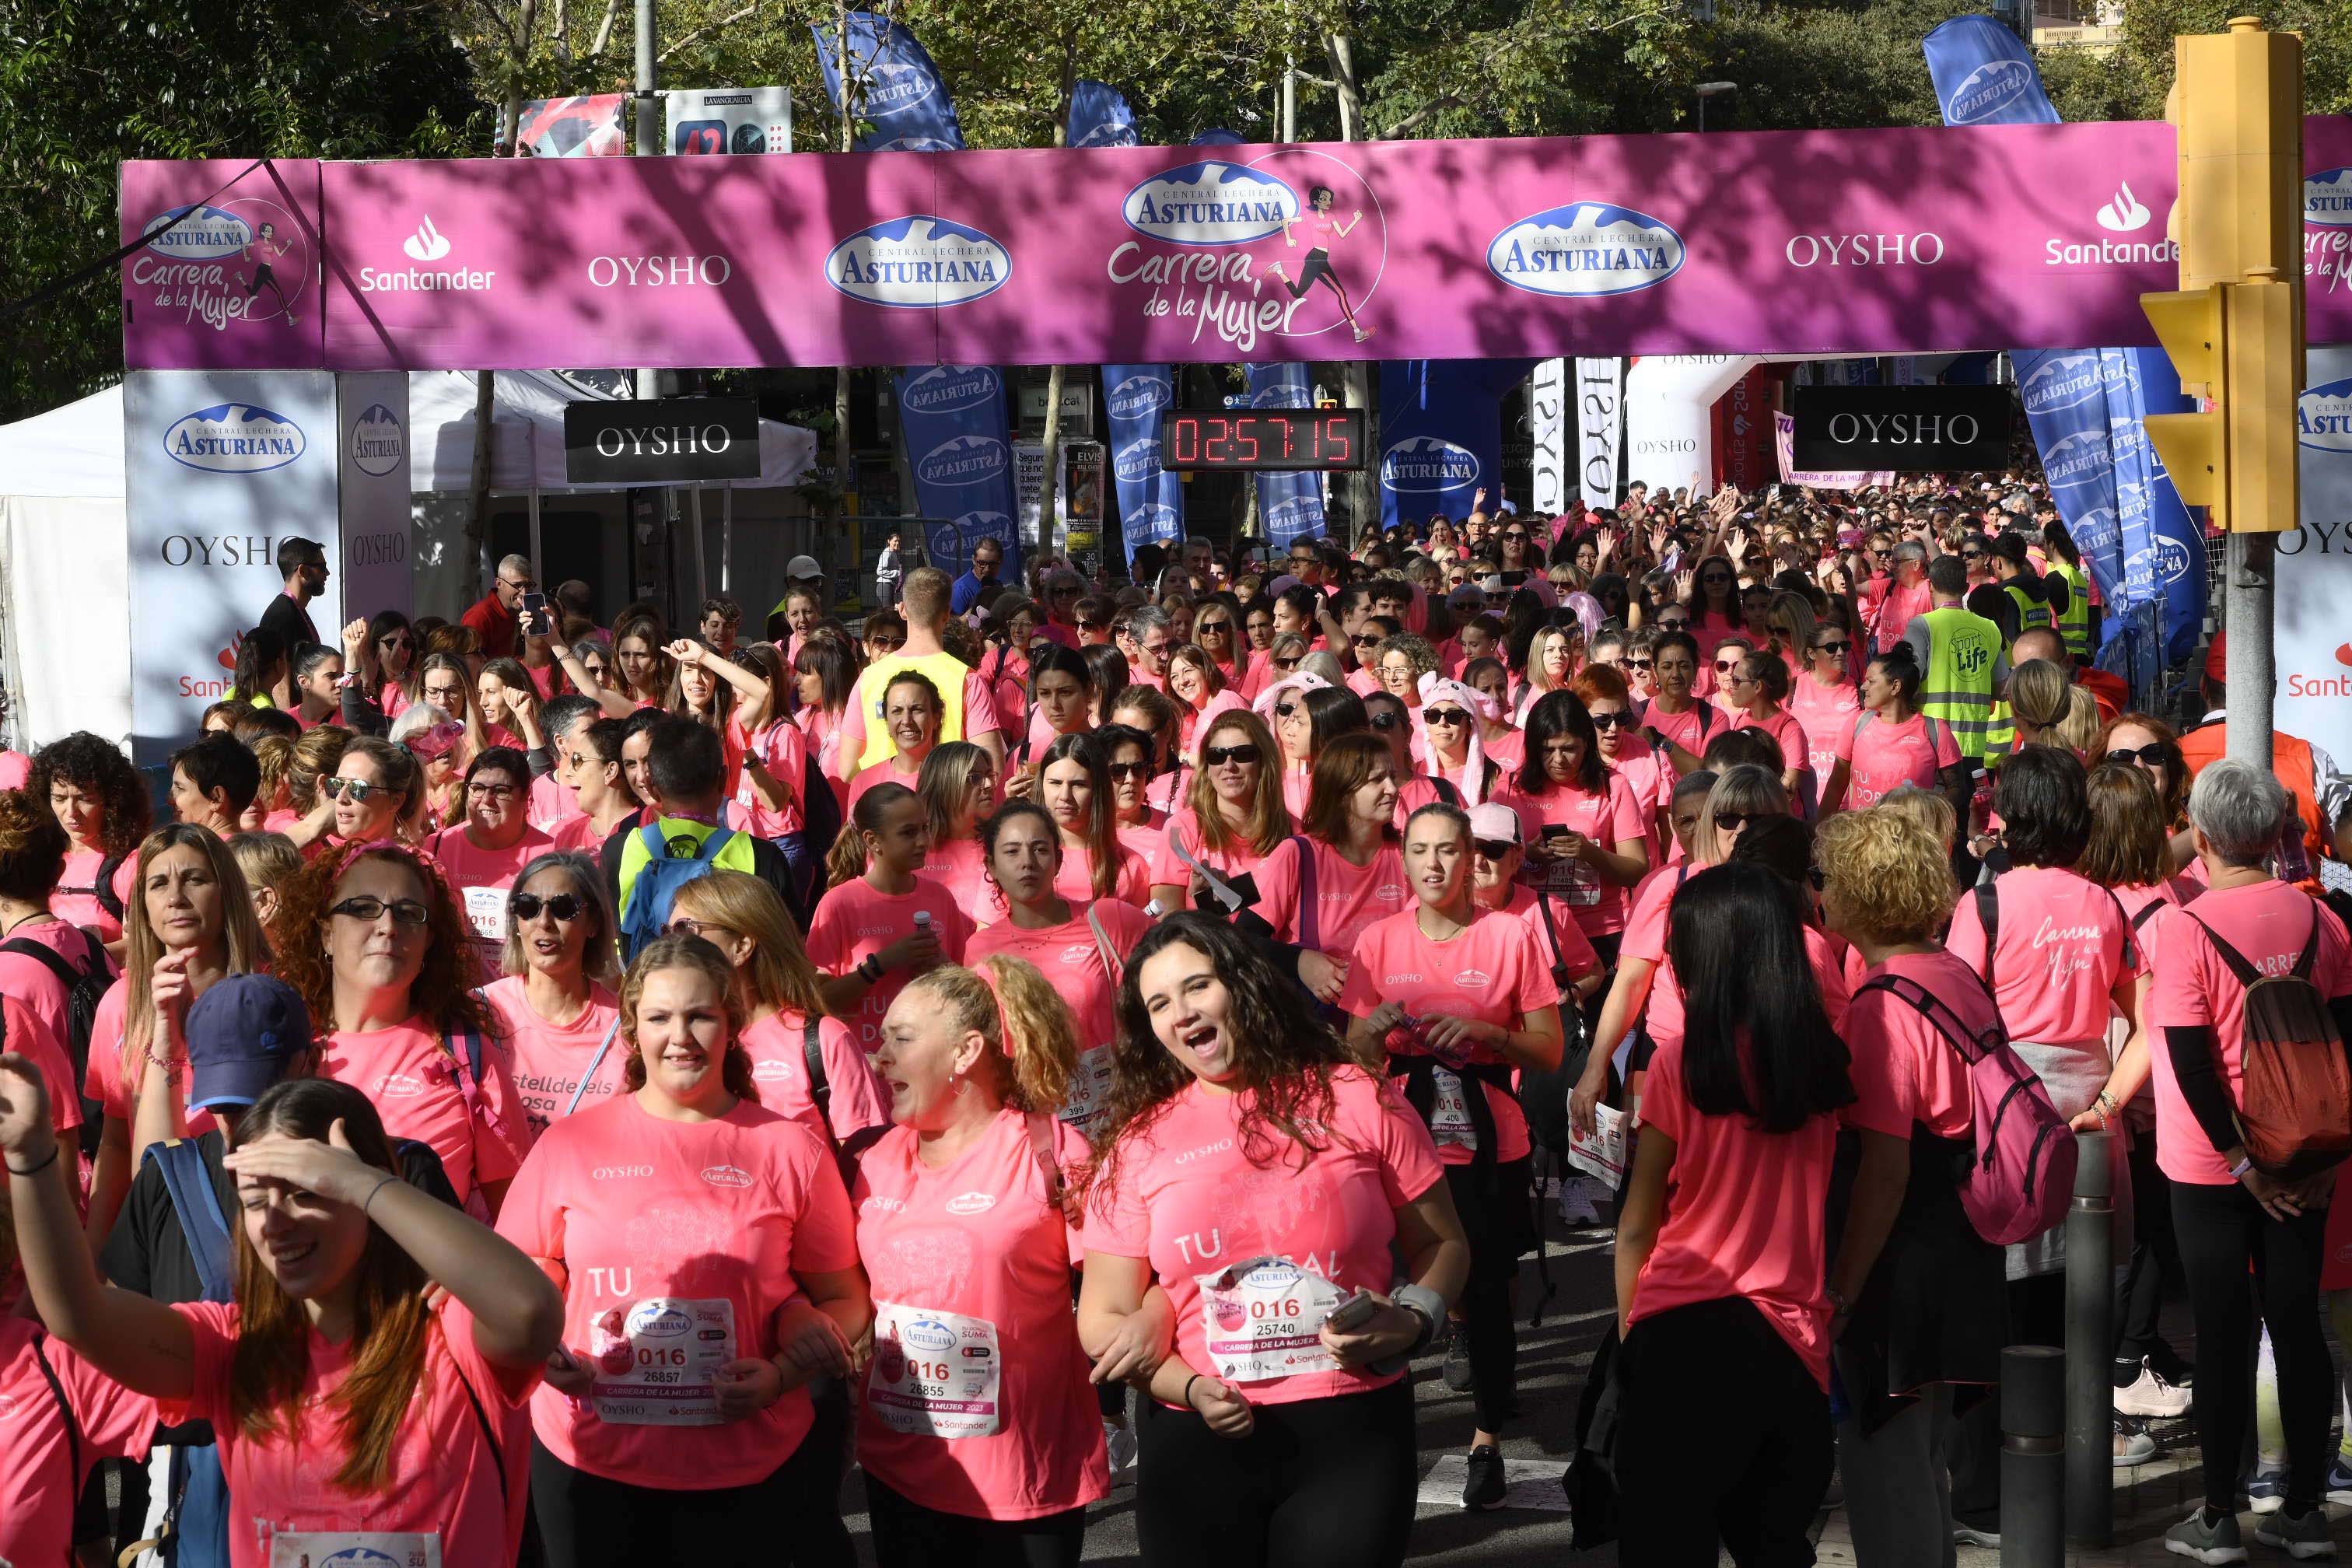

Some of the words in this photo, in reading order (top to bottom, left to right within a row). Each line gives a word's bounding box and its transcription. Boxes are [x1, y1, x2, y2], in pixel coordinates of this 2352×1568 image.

[1164, 191, 1218, 199] CENTRAL
[1224, 188, 1279, 198] LECHERA
[1136, 193, 1284, 224] ASTURIANA
[2305, 198, 2352, 212] STUR
[1534, 235, 1594, 245] CENTRAL
[1601, 233, 1663, 243] LECHERA
[933, 247, 991, 256] LECHERA
[1503, 239, 1670, 272] ASTURIANA
[1786, 233, 1944, 267] OYSHO
[2046, 237, 2180, 266] Santande
[132, 257, 223, 285] Carrera
[587, 255, 730, 287] OYSHO
[840, 250, 997, 284] ASTURIANA
[1108, 241, 1252, 285] Carrera
[359, 266, 495, 291] Santander
[156, 288, 171, 306] de
[176, 288, 187, 306] la
[186, 282, 258, 331] Mujer
[1143, 286, 1170, 317] de
[1176, 286, 1196, 317] la
[1192, 278, 1307, 352] Mujer
[1176, 418, 1349, 460] 02:57:15
[1829, 412, 1979, 445] OYSHO
[175, 429, 296, 456] ASTURIANA
[356, 431, 400, 458] ASTURIANA
[597, 424, 731, 457] OYSHO
[1637, 439, 1696, 454] OYSHO
[1078, 452, 1101, 461] ELVIS
[1384, 459, 1472, 481] ASTURIANA
[161, 535, 304, 566] OYSH
[353, 532, 404, 566] OYSHO
[1951, 632, 1983, 653] Sport
[1956, 647, 1988, 673] Life
[179, 676, 233, 697] Sant
[1319, 892, 1352, 901] OYSHO
[471, 915, 496, 926] 016
[2256, 953, 2298, 975] ARRE
[1386, 974, 1423, 985] OYSHO
[520, 1096, 557, 1111] osa
[1069, 1090, 1090, 1102] 16
[1439, 1098, 1462, 1110] 016
[1175, 1139, 1232, 1164] OYSHO
[593, 1165, 654, 1180] OYSHO
[1174, 1228, 1221, 1264] TU
[588, 1268, 632, 1297] TU
[1251, 1299, 1300, 1318] 016
[635, 1318, 687, 1331] ASTURIANA
[1257, 1323, 1294, 1336] 25740
[908, 1329, 952, 1346] ASTURIANA
[1224, 1342, 1259, 1352] CARRERA
[1286, 1338, 1314, 1346] MUJER
[638, 1348, 686, 1365] 016
[644, 1372, 680, 1383] 26857
[908, 1360, 950, 1381] 016
[910, 1383, 943, 1397] 26855
[602, 1405, 645, 1415] OYSHO
[936, 1402, 963, 1411] MUJER
[944, 1420, 987, 1430] Santander
